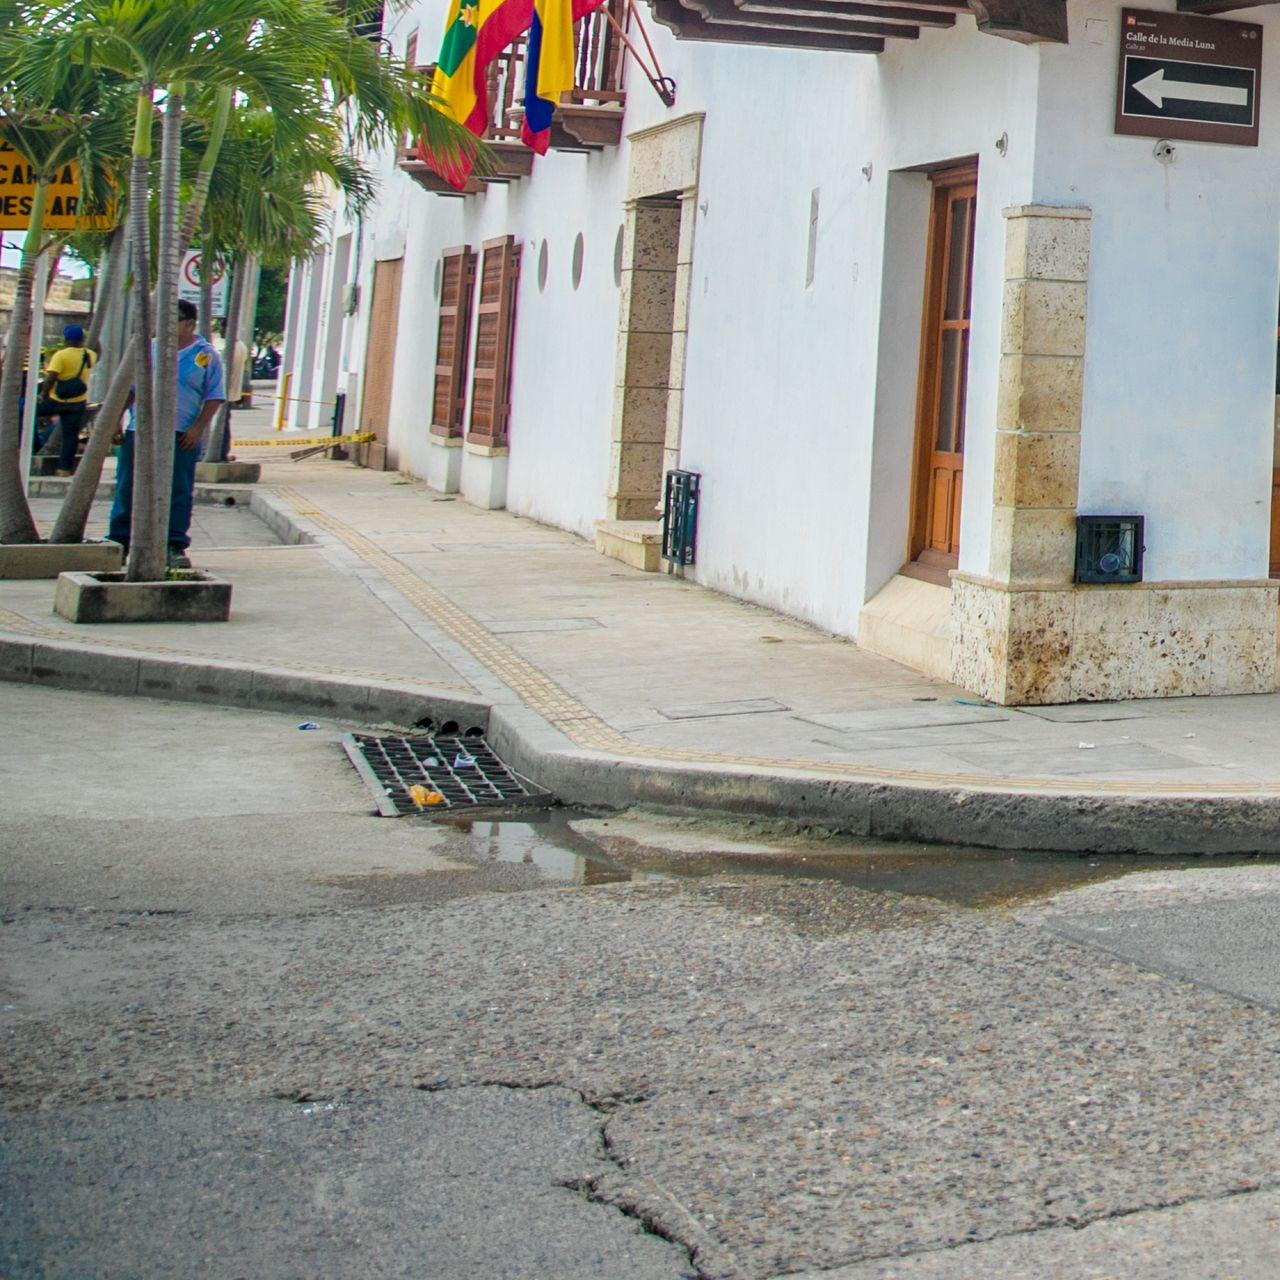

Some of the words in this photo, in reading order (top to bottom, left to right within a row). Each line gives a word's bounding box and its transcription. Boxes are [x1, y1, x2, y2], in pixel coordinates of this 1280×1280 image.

[1126, 32, 1147, 43] Calle
[1148, 34, 1159, 44] de
[1159, 35, 1168, 44] la
[1168, 37, 1194, 48] Media
[1195, 40, 1215, 50] Luna
